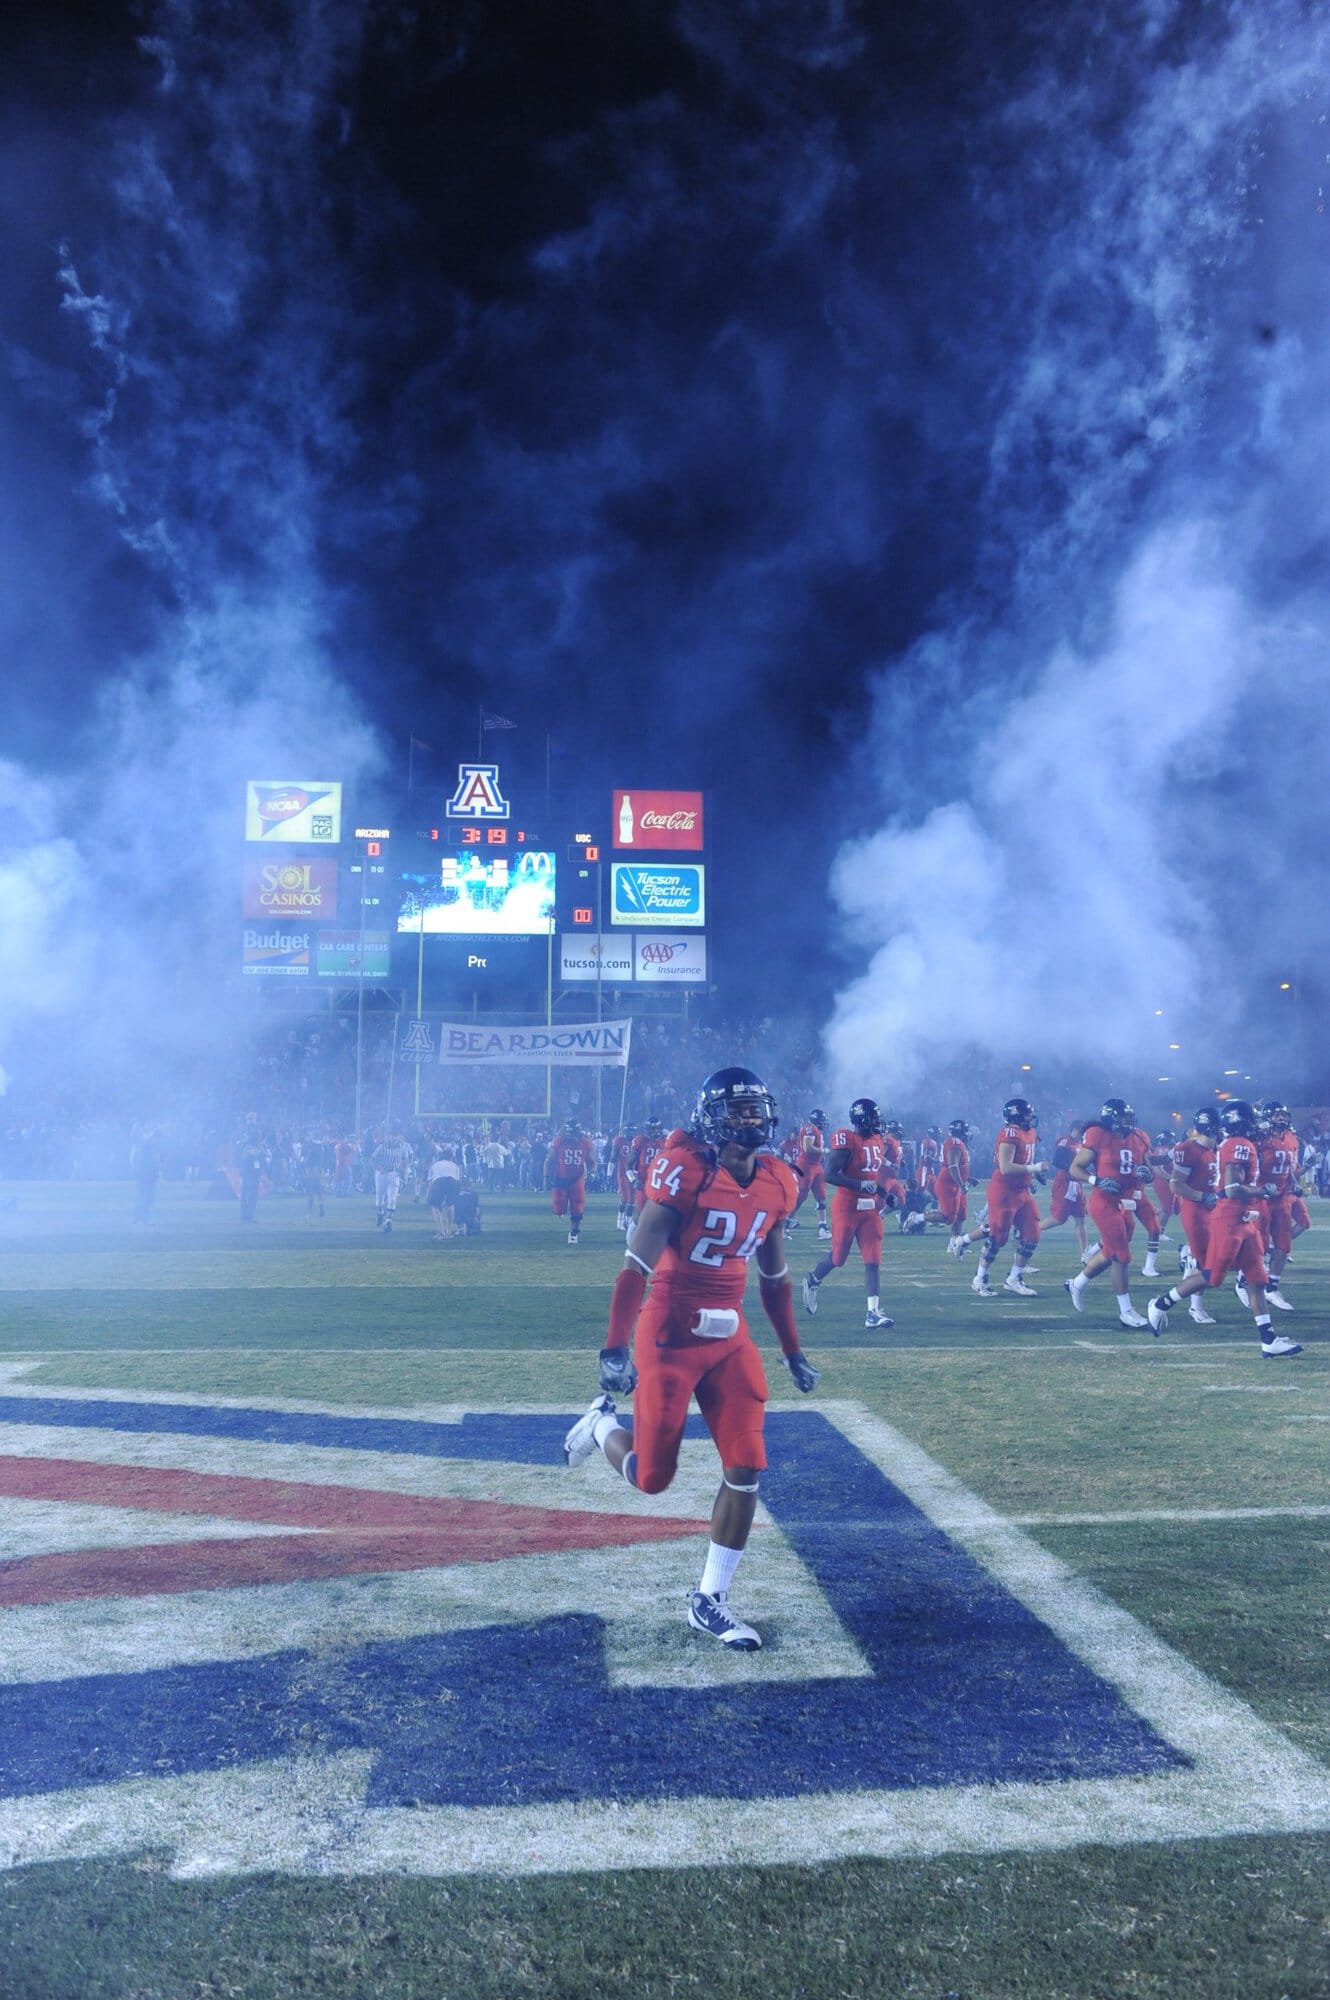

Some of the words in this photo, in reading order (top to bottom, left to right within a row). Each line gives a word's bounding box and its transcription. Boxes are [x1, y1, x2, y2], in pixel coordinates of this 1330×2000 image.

[446, 763, 510, 819] A
[266, 799, 300, 810] NCAA
[640, 810, 698, 830] Coca-Cola
[355, 829, 390, 838] ARIZONA
[431, 829, 439, 840] 3
[517, 831, 525, 842] 3
[575, 833, 592, 843] USC
[259, 864, 322, 893] SOL
[637, 872, 681, 885] Tucson
[641, 885, 693, 896] Electric
[259, 893, 322, 906] CASINOS
[646, 895, 693, 908] Power
[243, 929, 311, 953] Budget
[645, 945, 670, 961] AAA
[563, 958, 631, 969] tucson.com
[658, 965, 702, 975] Insurance
[1004, 1128, 1016, 1137] 76
[834, 1133, 847, 1146] 15
[564, 1149, 583, 1166] 55
[862, 1145, 882, 1172] 15
[650, 1157, 685, 1197] 24
